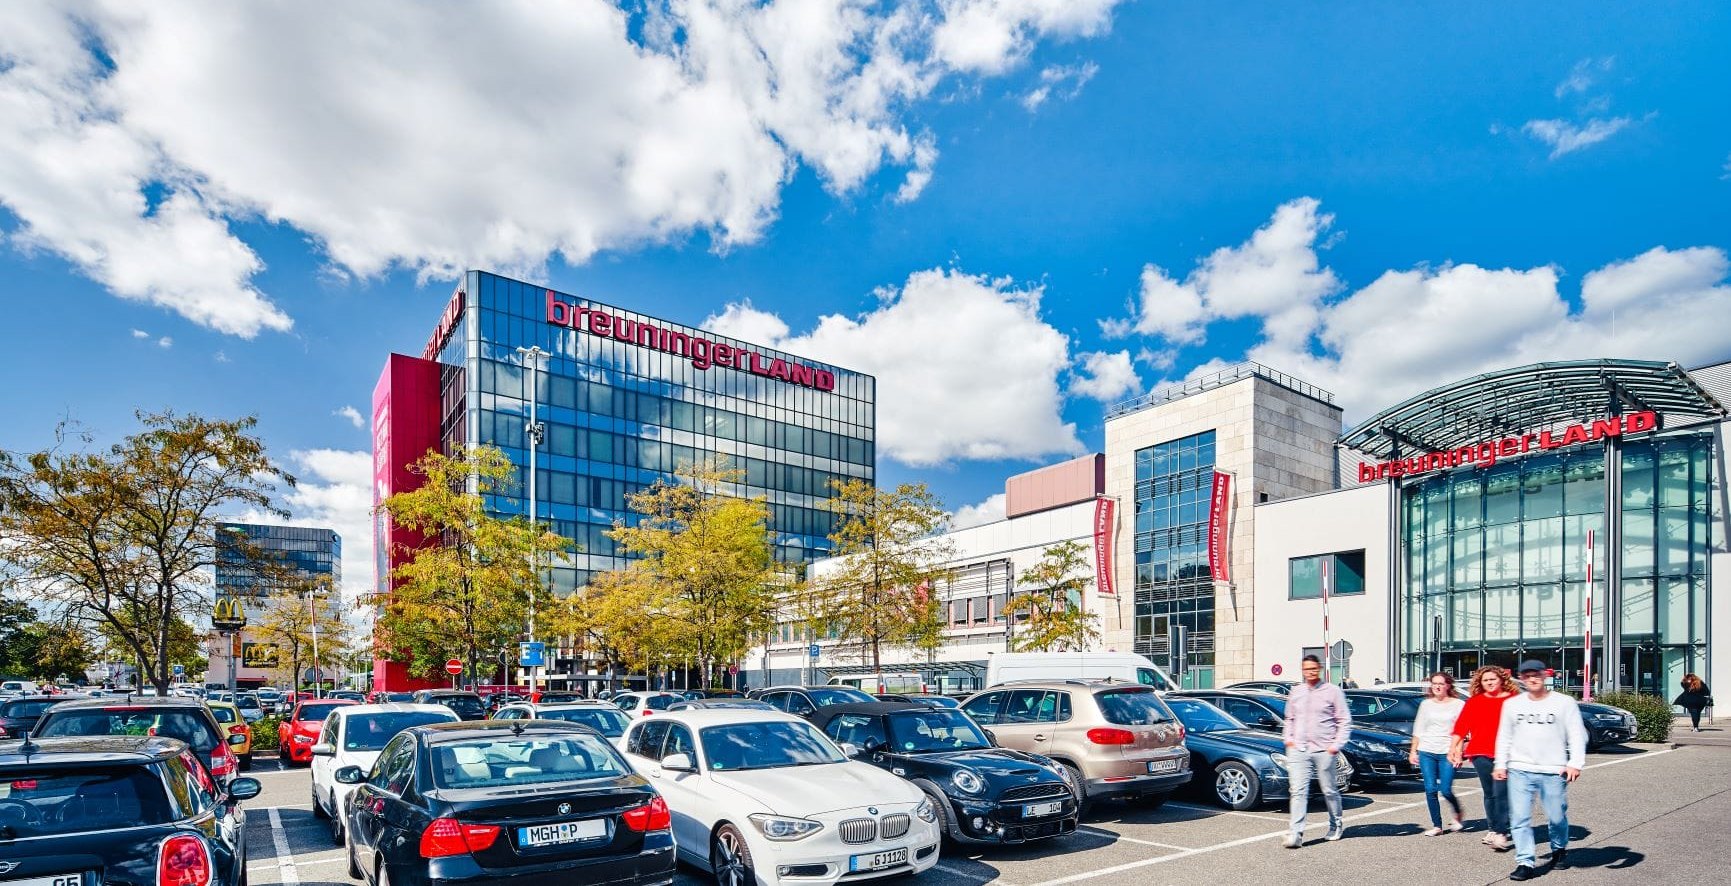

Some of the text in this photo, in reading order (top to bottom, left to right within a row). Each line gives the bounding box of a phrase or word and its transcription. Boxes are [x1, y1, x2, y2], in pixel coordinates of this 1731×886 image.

[546, 289, 834, 392] breuningerLAND
[1358, 410, 1659, 484] breuningerLAND
[1515, 713, 1556, 725] POLO
[530, 826, 559, 843] MGH
[569, 823, 578, 837] P
